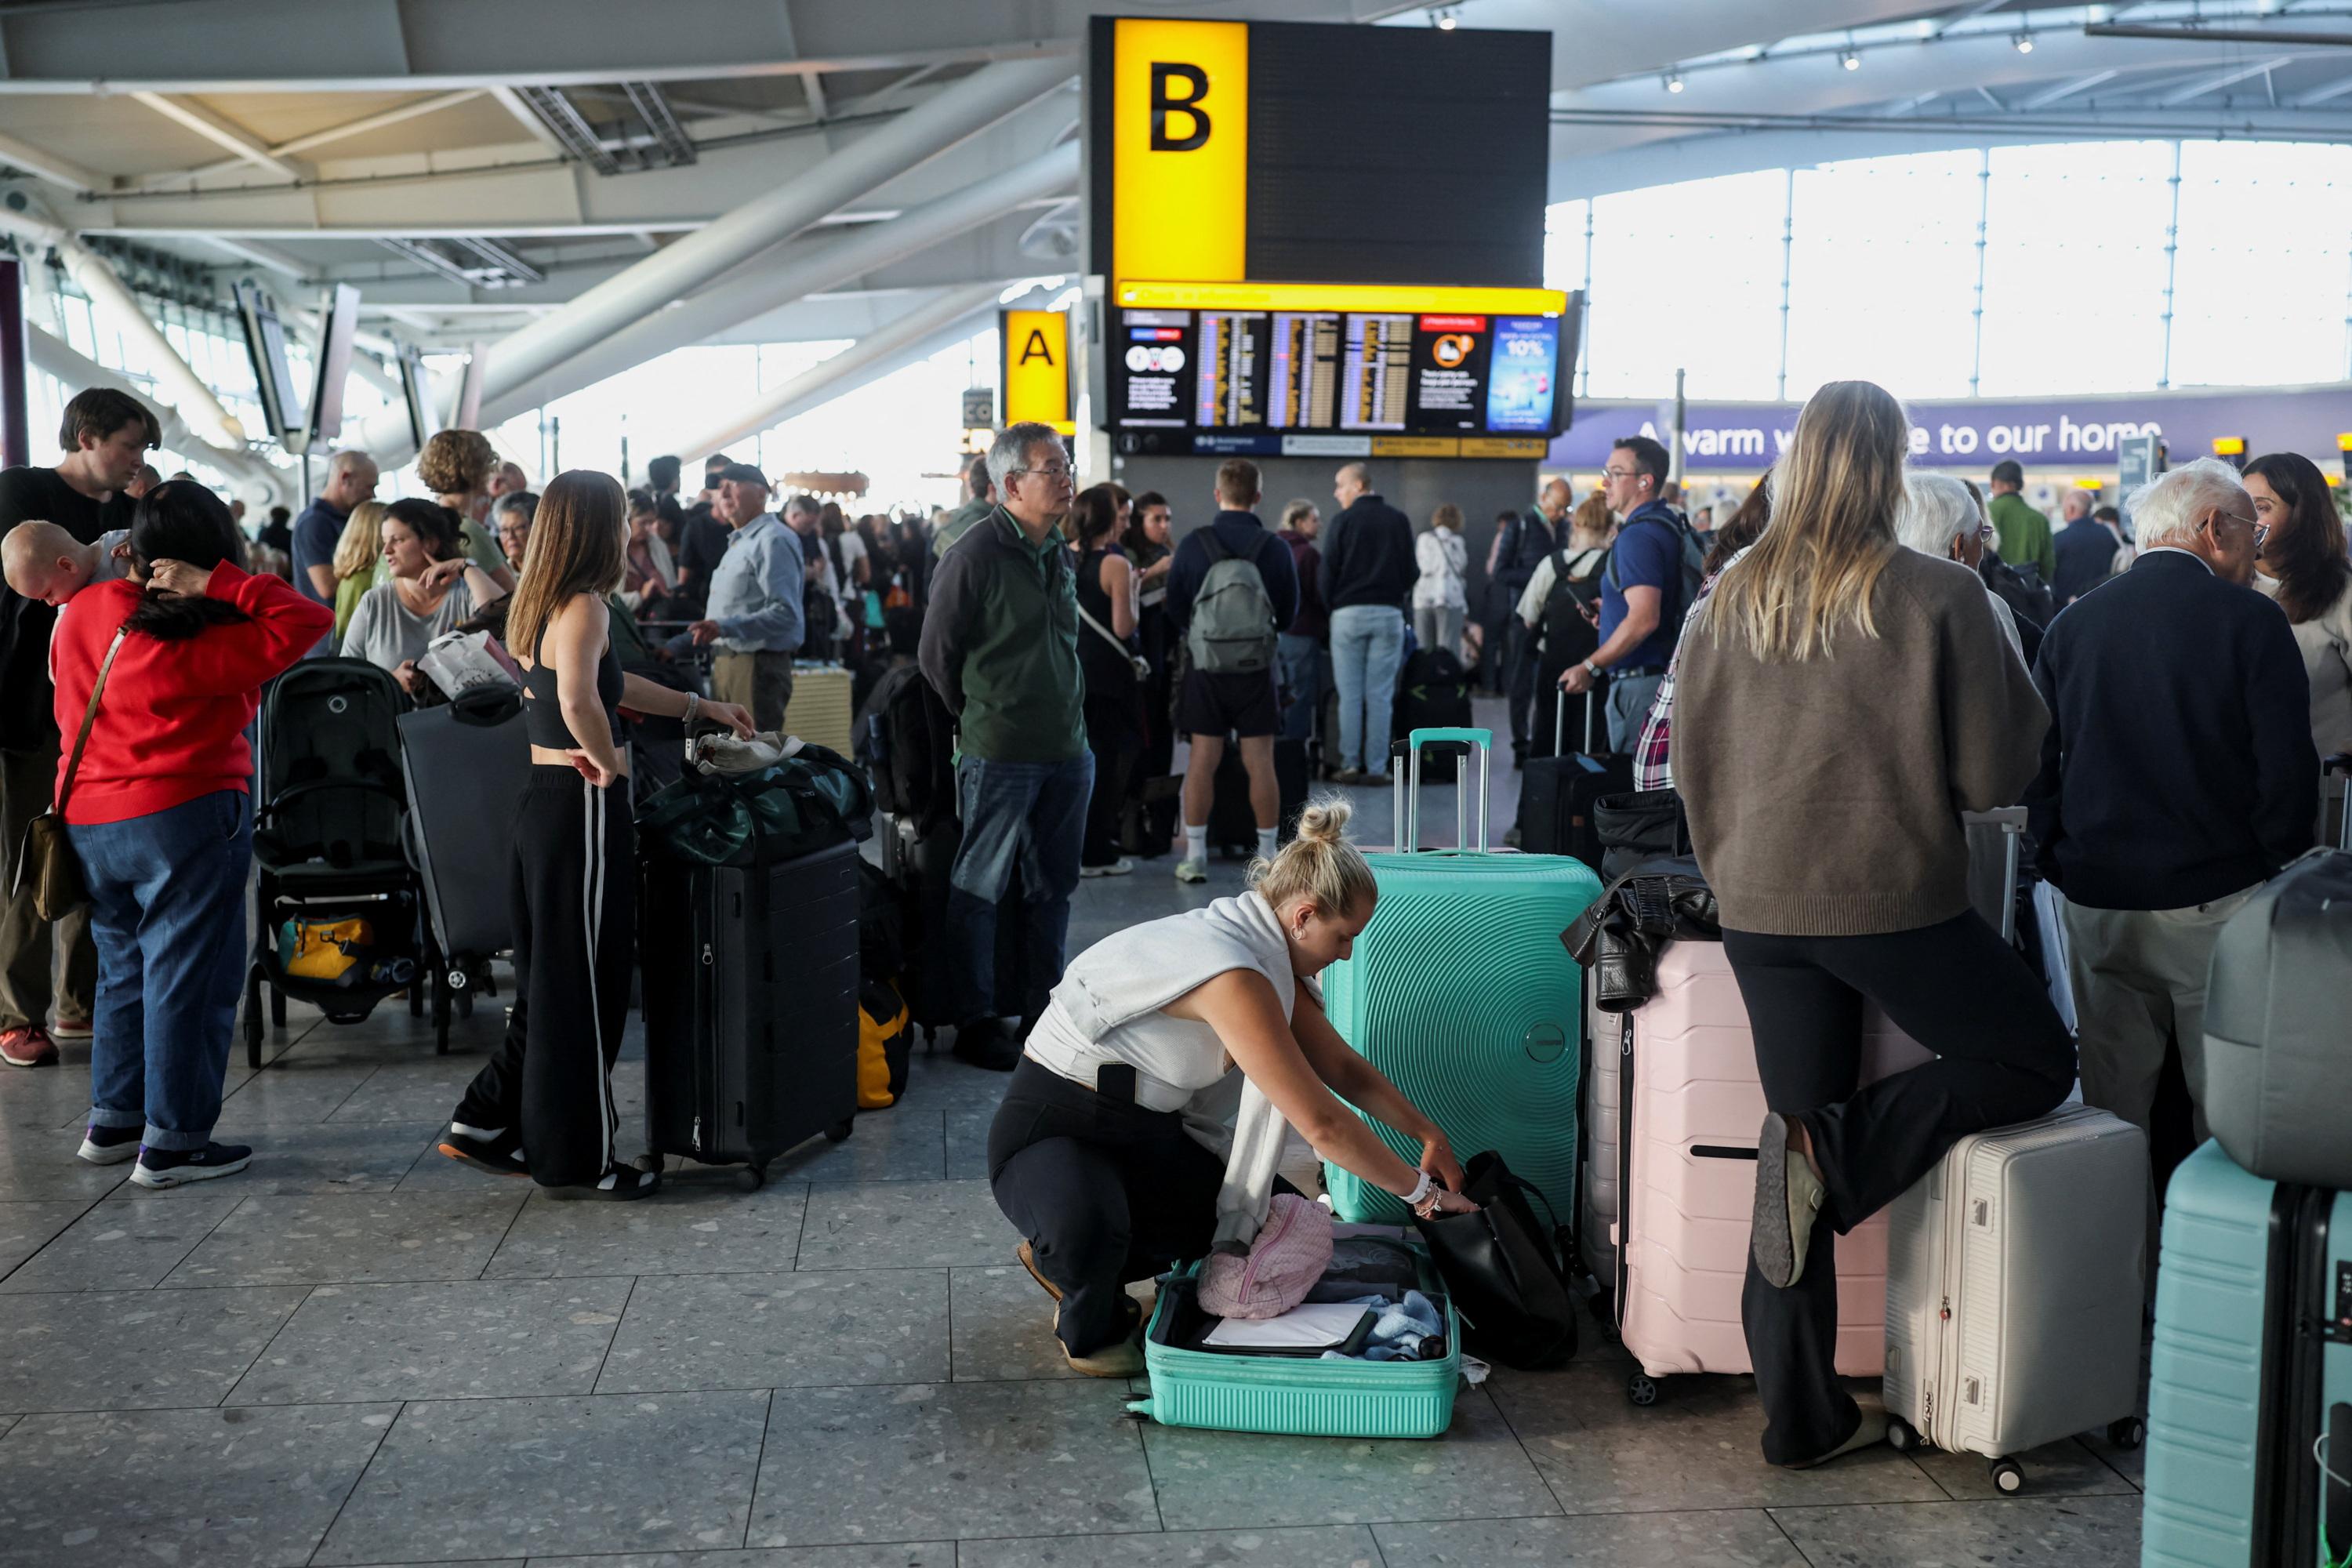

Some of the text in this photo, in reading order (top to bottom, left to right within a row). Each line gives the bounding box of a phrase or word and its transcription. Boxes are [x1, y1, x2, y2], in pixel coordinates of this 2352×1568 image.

[1149, 61, 1211, 151] B
[1019, 328, 1054, 367] A
[1940, 423, 1979, 455] to
[1987, 424, 2052, 454] our
